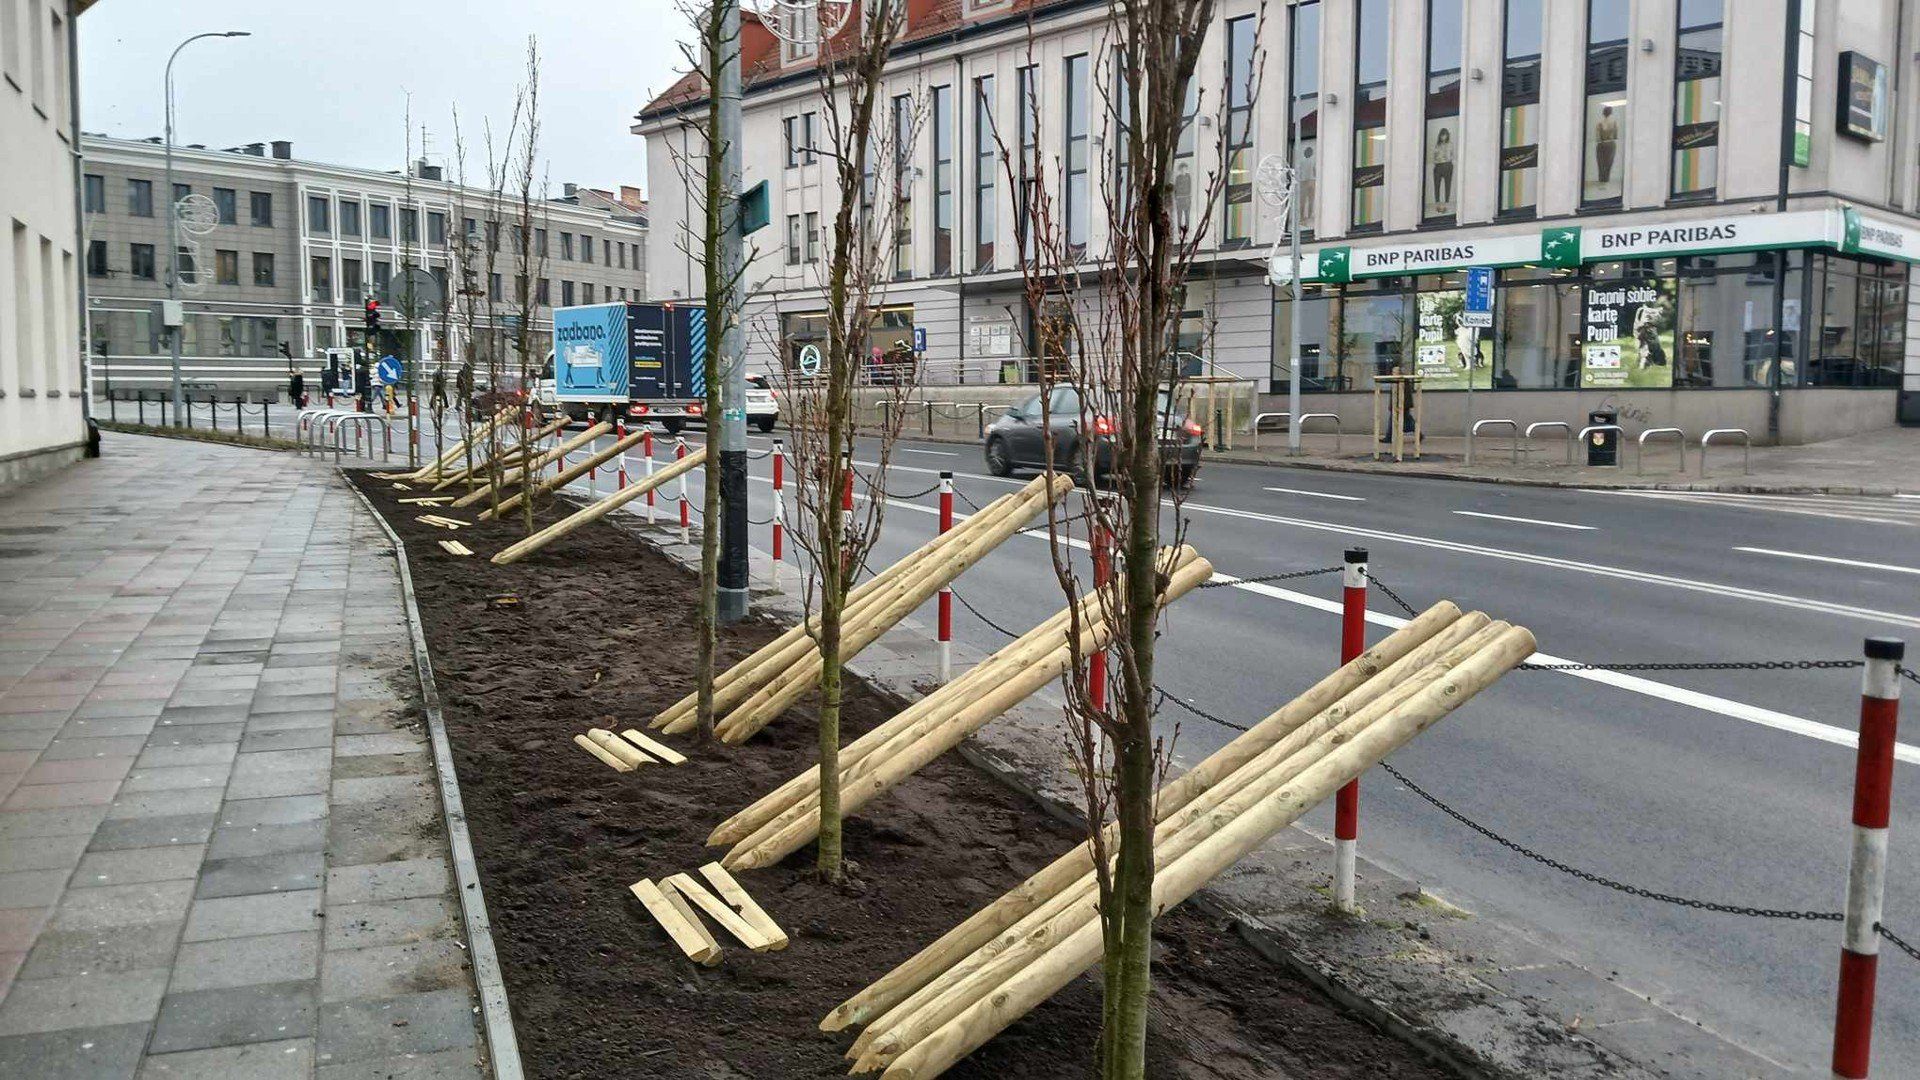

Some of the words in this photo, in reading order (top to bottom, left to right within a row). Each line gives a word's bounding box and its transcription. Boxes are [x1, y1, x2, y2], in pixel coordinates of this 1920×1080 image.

[1601, 232, 1642, 248] BNP
[1647, 224, 1737, 244] PARIBAS
[1366, 251, 1399, 266] BNP
[1404, 245, 1475, 263] PARIBAS
[1588, 288, 1625, 306] Drapnij
[1627, 287, 1657, 303] sobie
[1464, 314, 1491, 326] Koniec
[915, 331, 922, 348] P
[1419, 328, 1443, 343] Pupil
[1587, 325, 1618, 343] Pupil
